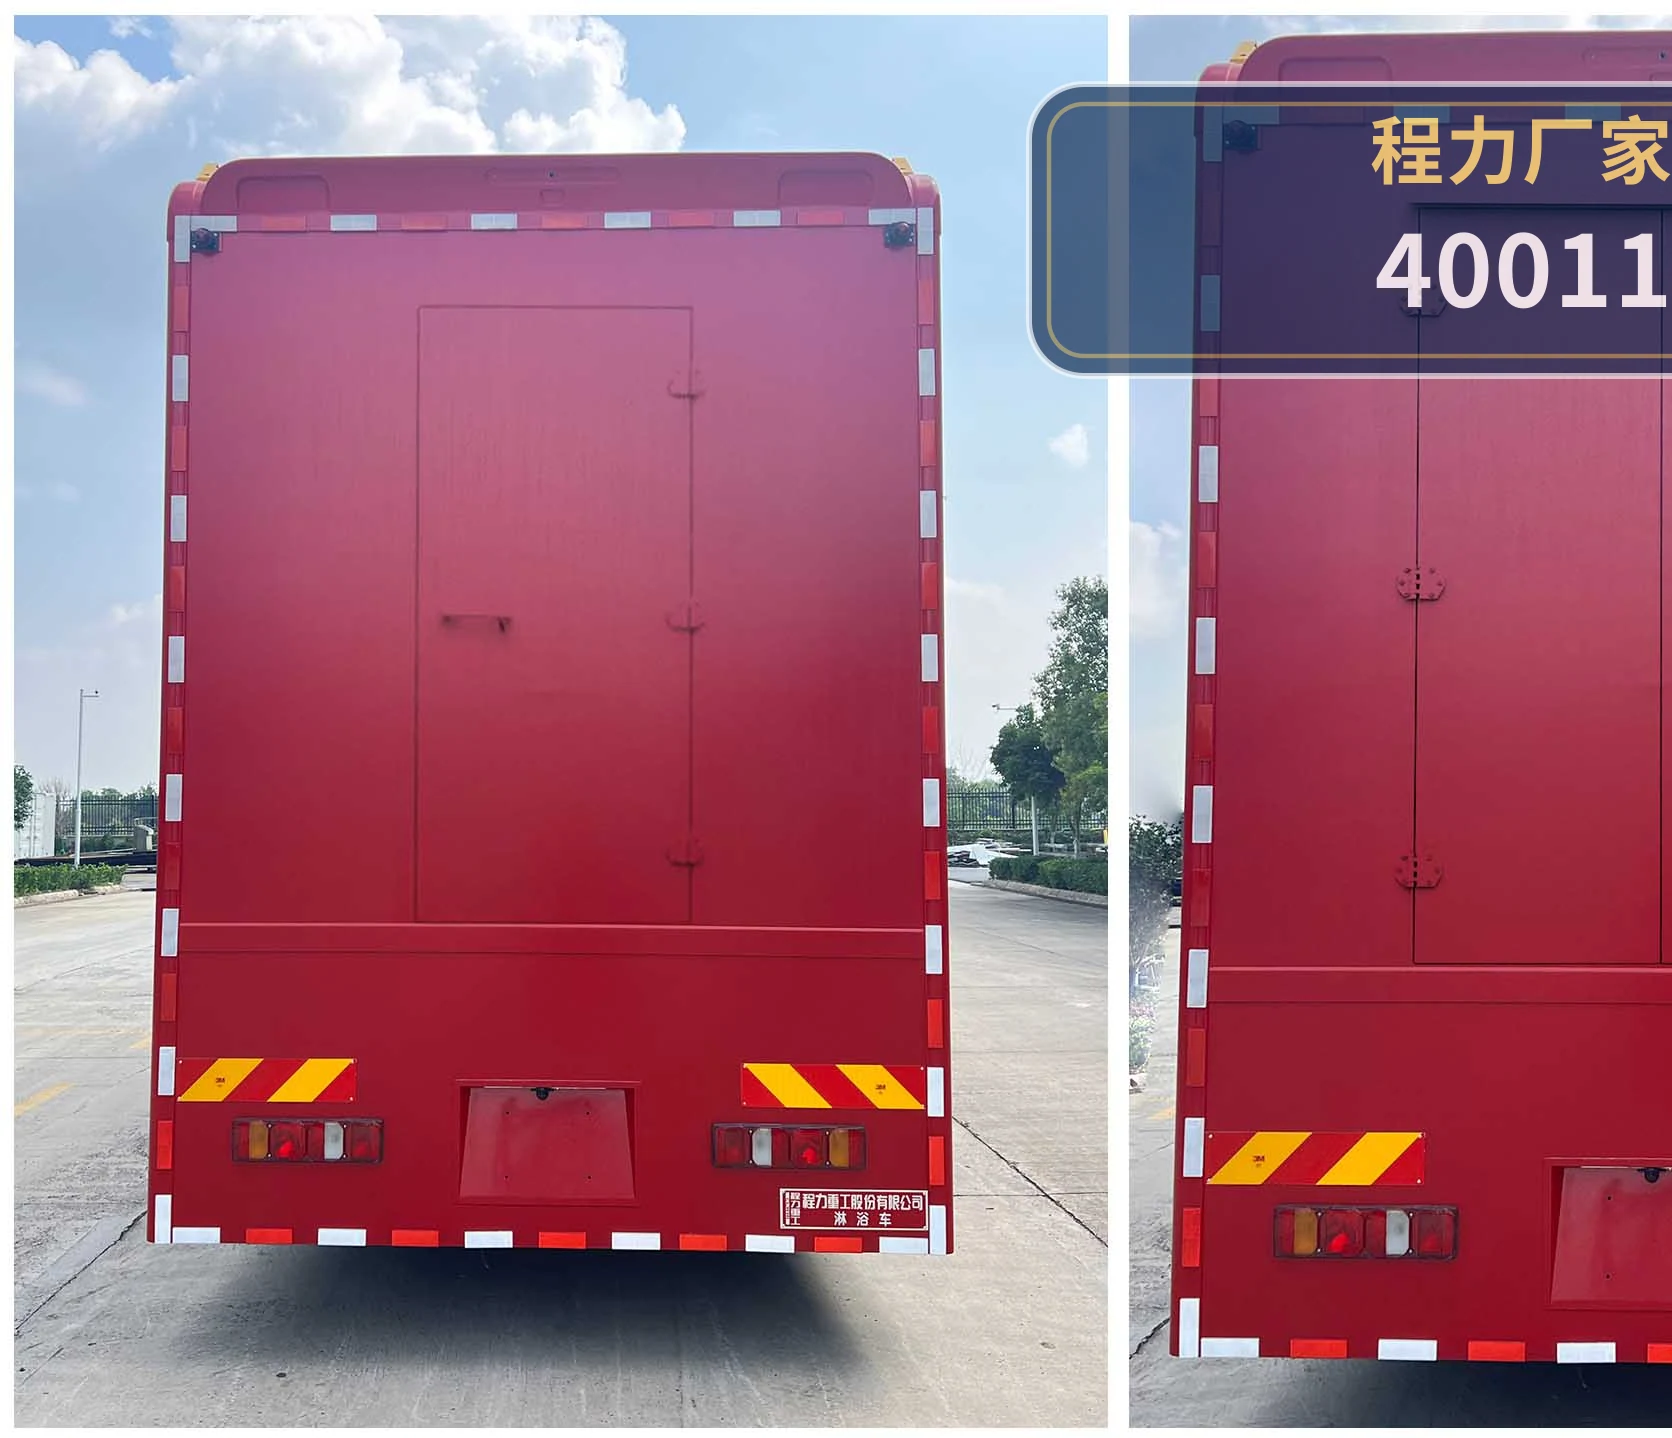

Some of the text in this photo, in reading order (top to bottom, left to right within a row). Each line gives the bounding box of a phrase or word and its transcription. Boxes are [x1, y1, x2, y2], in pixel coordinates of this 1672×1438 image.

[802, 1192, 924, 1211] 程力重工股份有限公司
